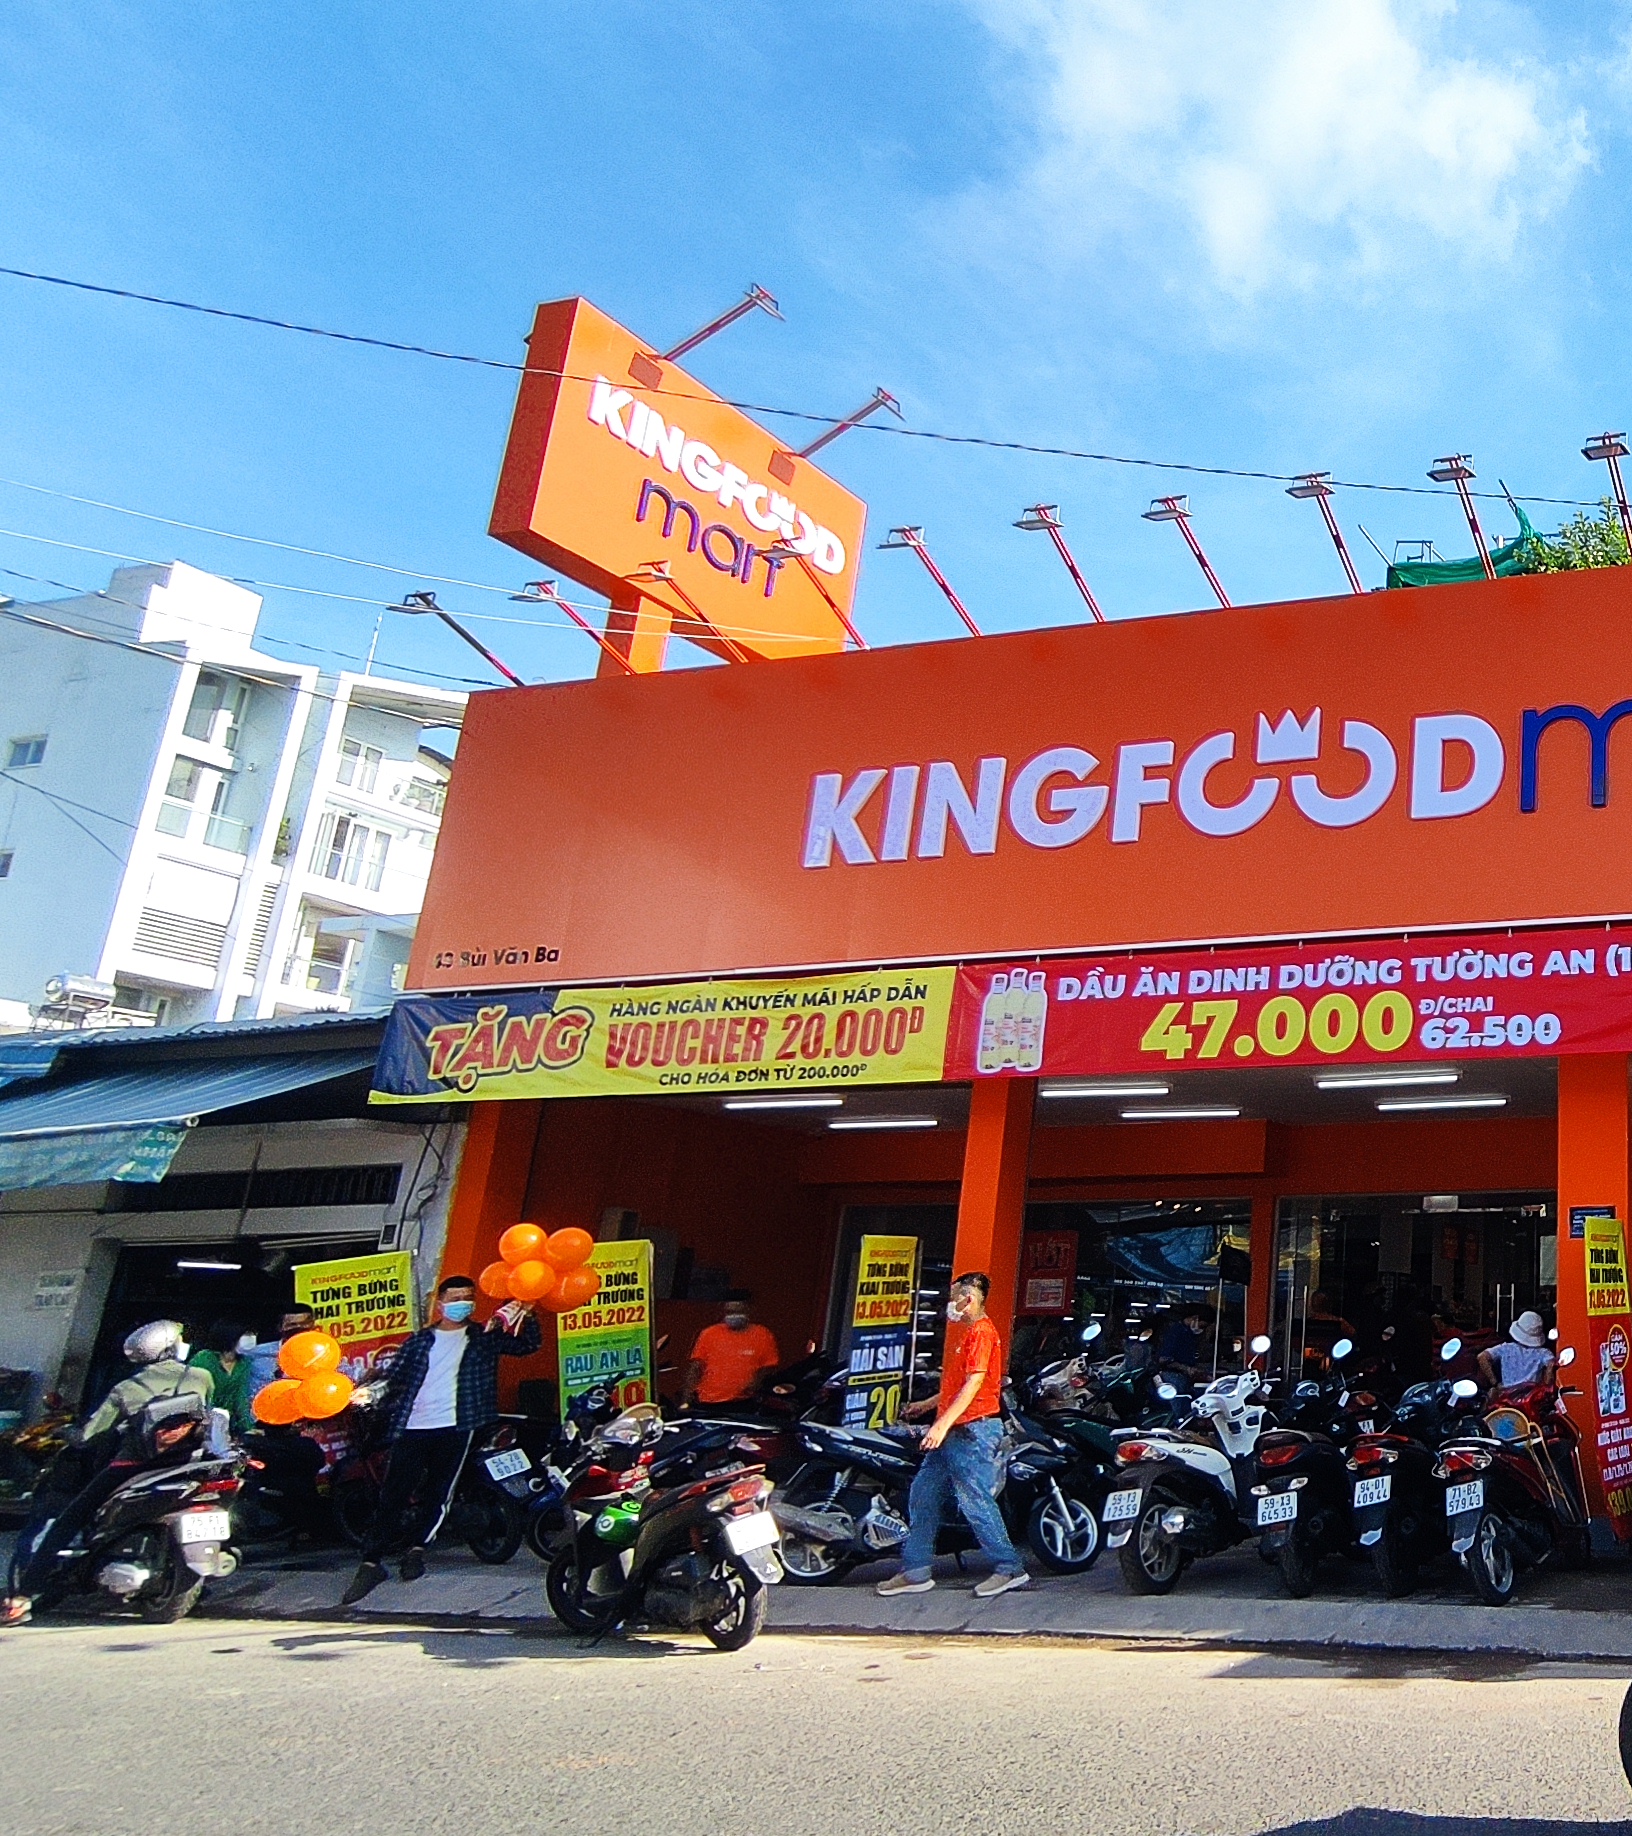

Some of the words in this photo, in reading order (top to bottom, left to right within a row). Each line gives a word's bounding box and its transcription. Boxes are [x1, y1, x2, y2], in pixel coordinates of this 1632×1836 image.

[636, 479, 785, 599] mart
[493, 946, 530, 966] Văn
[534, 945, 560, 963] Ba
[1057, 966, 1127, 1001] DẦU
[1132, 965, 1181, 997] ĂN
[1187, 966, 1271, 994] DINH
[1277, 952, 1403, 990] DƯỠNG
[1410, 947, 1535, 983] TƯỜNG
[1541, 948, 1597, 976] AN
[608, 997, 661, 1018] HÀNG
[665, 993, 717, 1015] NGÀN
[721, 988, 800, 1012] KHUYẾN
[801, 986, 838, 1008] MÃI
[841, 982, 883, 1005] HẤP
[886, 977, 928, 1001] DẪN
[604, 1016, 770, 1069] VOUCHER
[1140, 989, 1415, 1061] 47.000
[1418, 995, 1494, 1016] Đ/CHAI
[1419, 1013, 1562, 1050] 62.500
[428, 1004, 593, 1090] TẶNG
[658, 1072, 692, 1087] CHO
[696, 1067, 731, 1085] HÓA
[735, 1067, 770, 1083] ĐƠN
[774, 1063, 796, 1081] TỪ
[312, 1302, 342, 1321] HAI
[560, 1305, 646, 1332] 13.05.2022
[855, 1299, 910, 1321] 13.05.2022
[565, 1354, 594, 1374] RAU
